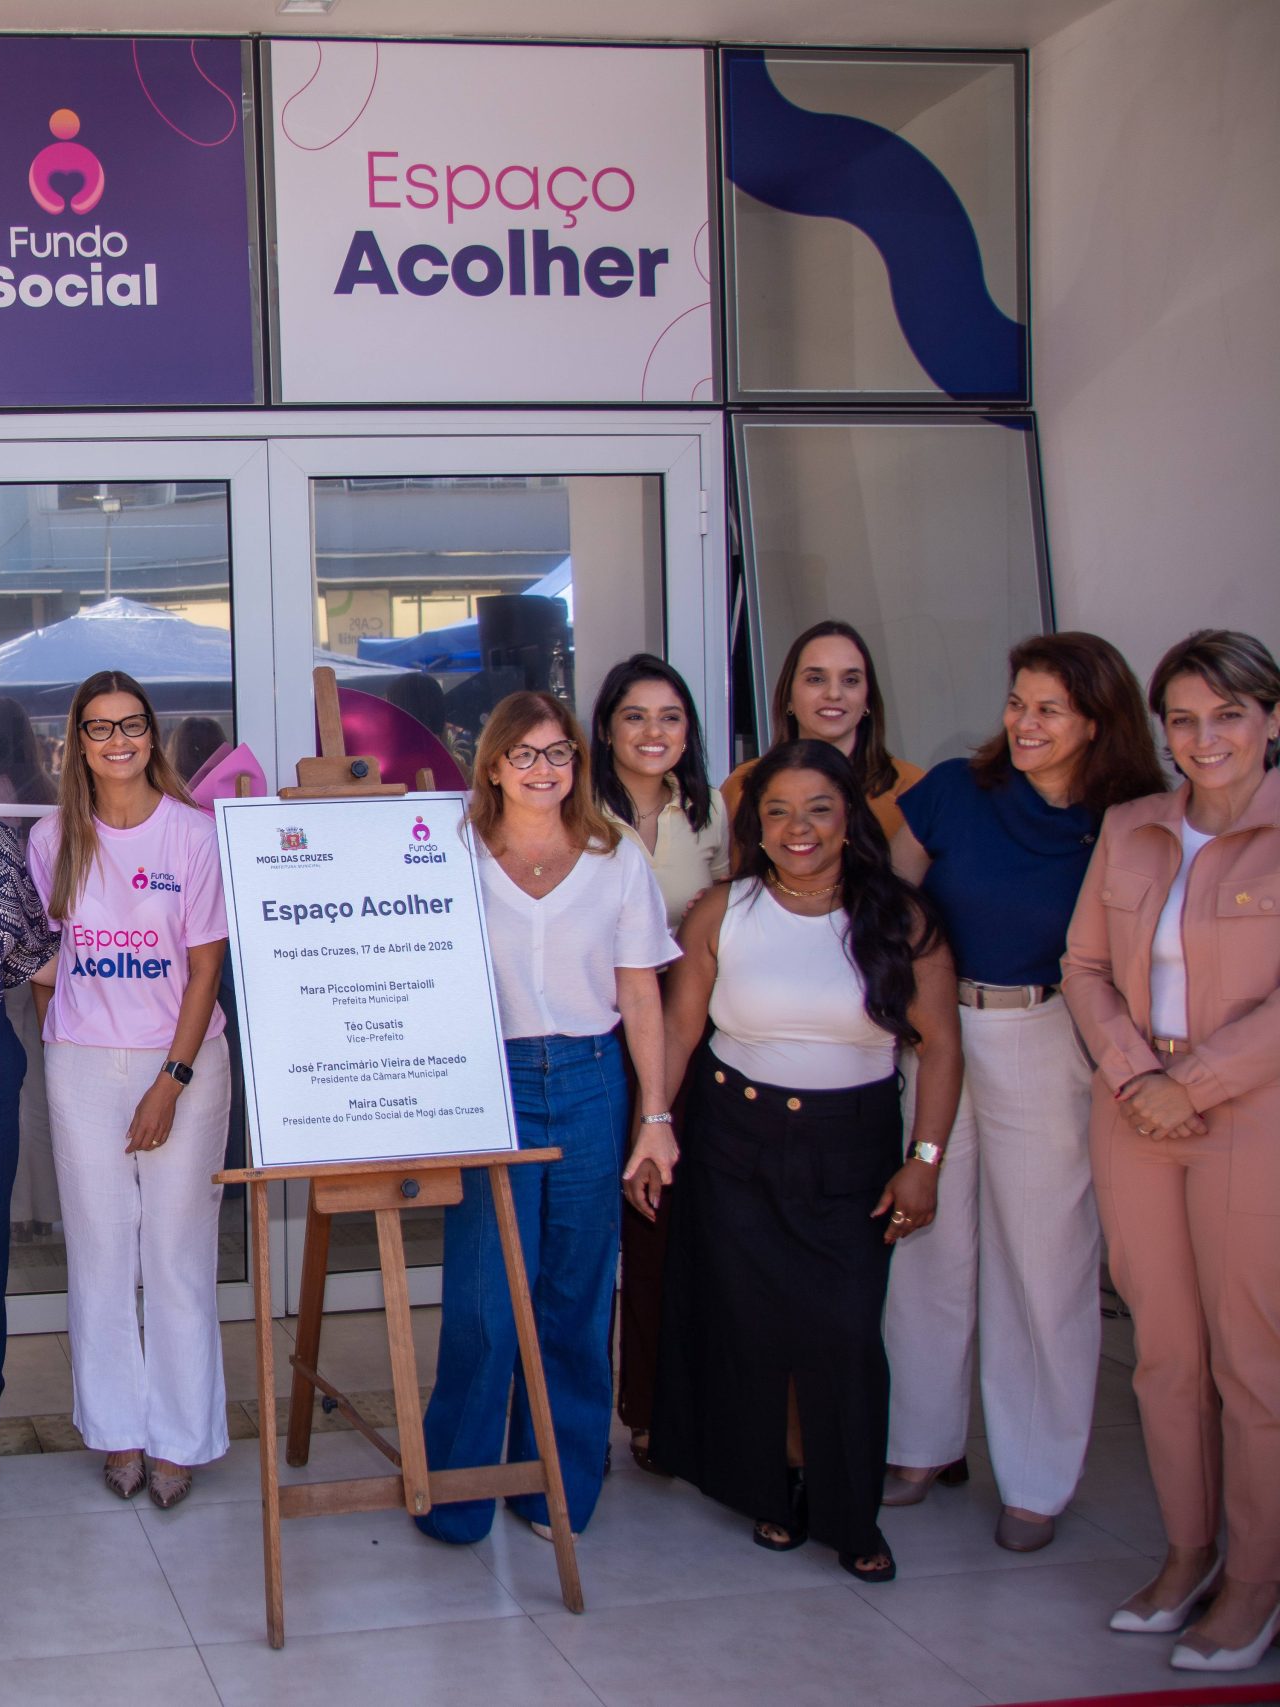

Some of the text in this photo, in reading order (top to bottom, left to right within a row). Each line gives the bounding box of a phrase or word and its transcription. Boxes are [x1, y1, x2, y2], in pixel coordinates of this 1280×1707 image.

[367, 150, 635, 229] Espaço
[9, 224, 128, 258] Fundo
[333, 228, 669, 298] Acolher
[409, 843, 438, 851] Fundo
[300, 854, 333, 862] CRUZES
[404, 852, 446, 864] Social
[150, 872, 174, 881] Fundo
[150, 881, 181, 893] Socia
[262, 895, 452, 925] Espaço Acolher
[72, 925, 159, 954] Espaço
[274, 941, 453, 959] Mogi das Cruzes, 17 de Abril de 2026
[70, 952, 172, 979] Acolher
[300, 979, 434, 995] Mara Piccolomini Bertaiolli
[332, 994, 408, 1006] Prefeita Municipal
[344, 1019, 403, 1031] Téo Cusatis
[347, 1032, 403, 1043] Vice-Prefeito
[289, 1054, 466, 1073] José Francimário Vieira de Macedo
[312, 1068, 448, 1085] Presidente da Câmara Municipal
[349, 1096, 418, 1109] Maira Cusatis
[283, 1105, 484, 1125] Presidente do Fundo Social de Mogi das Cruzes
